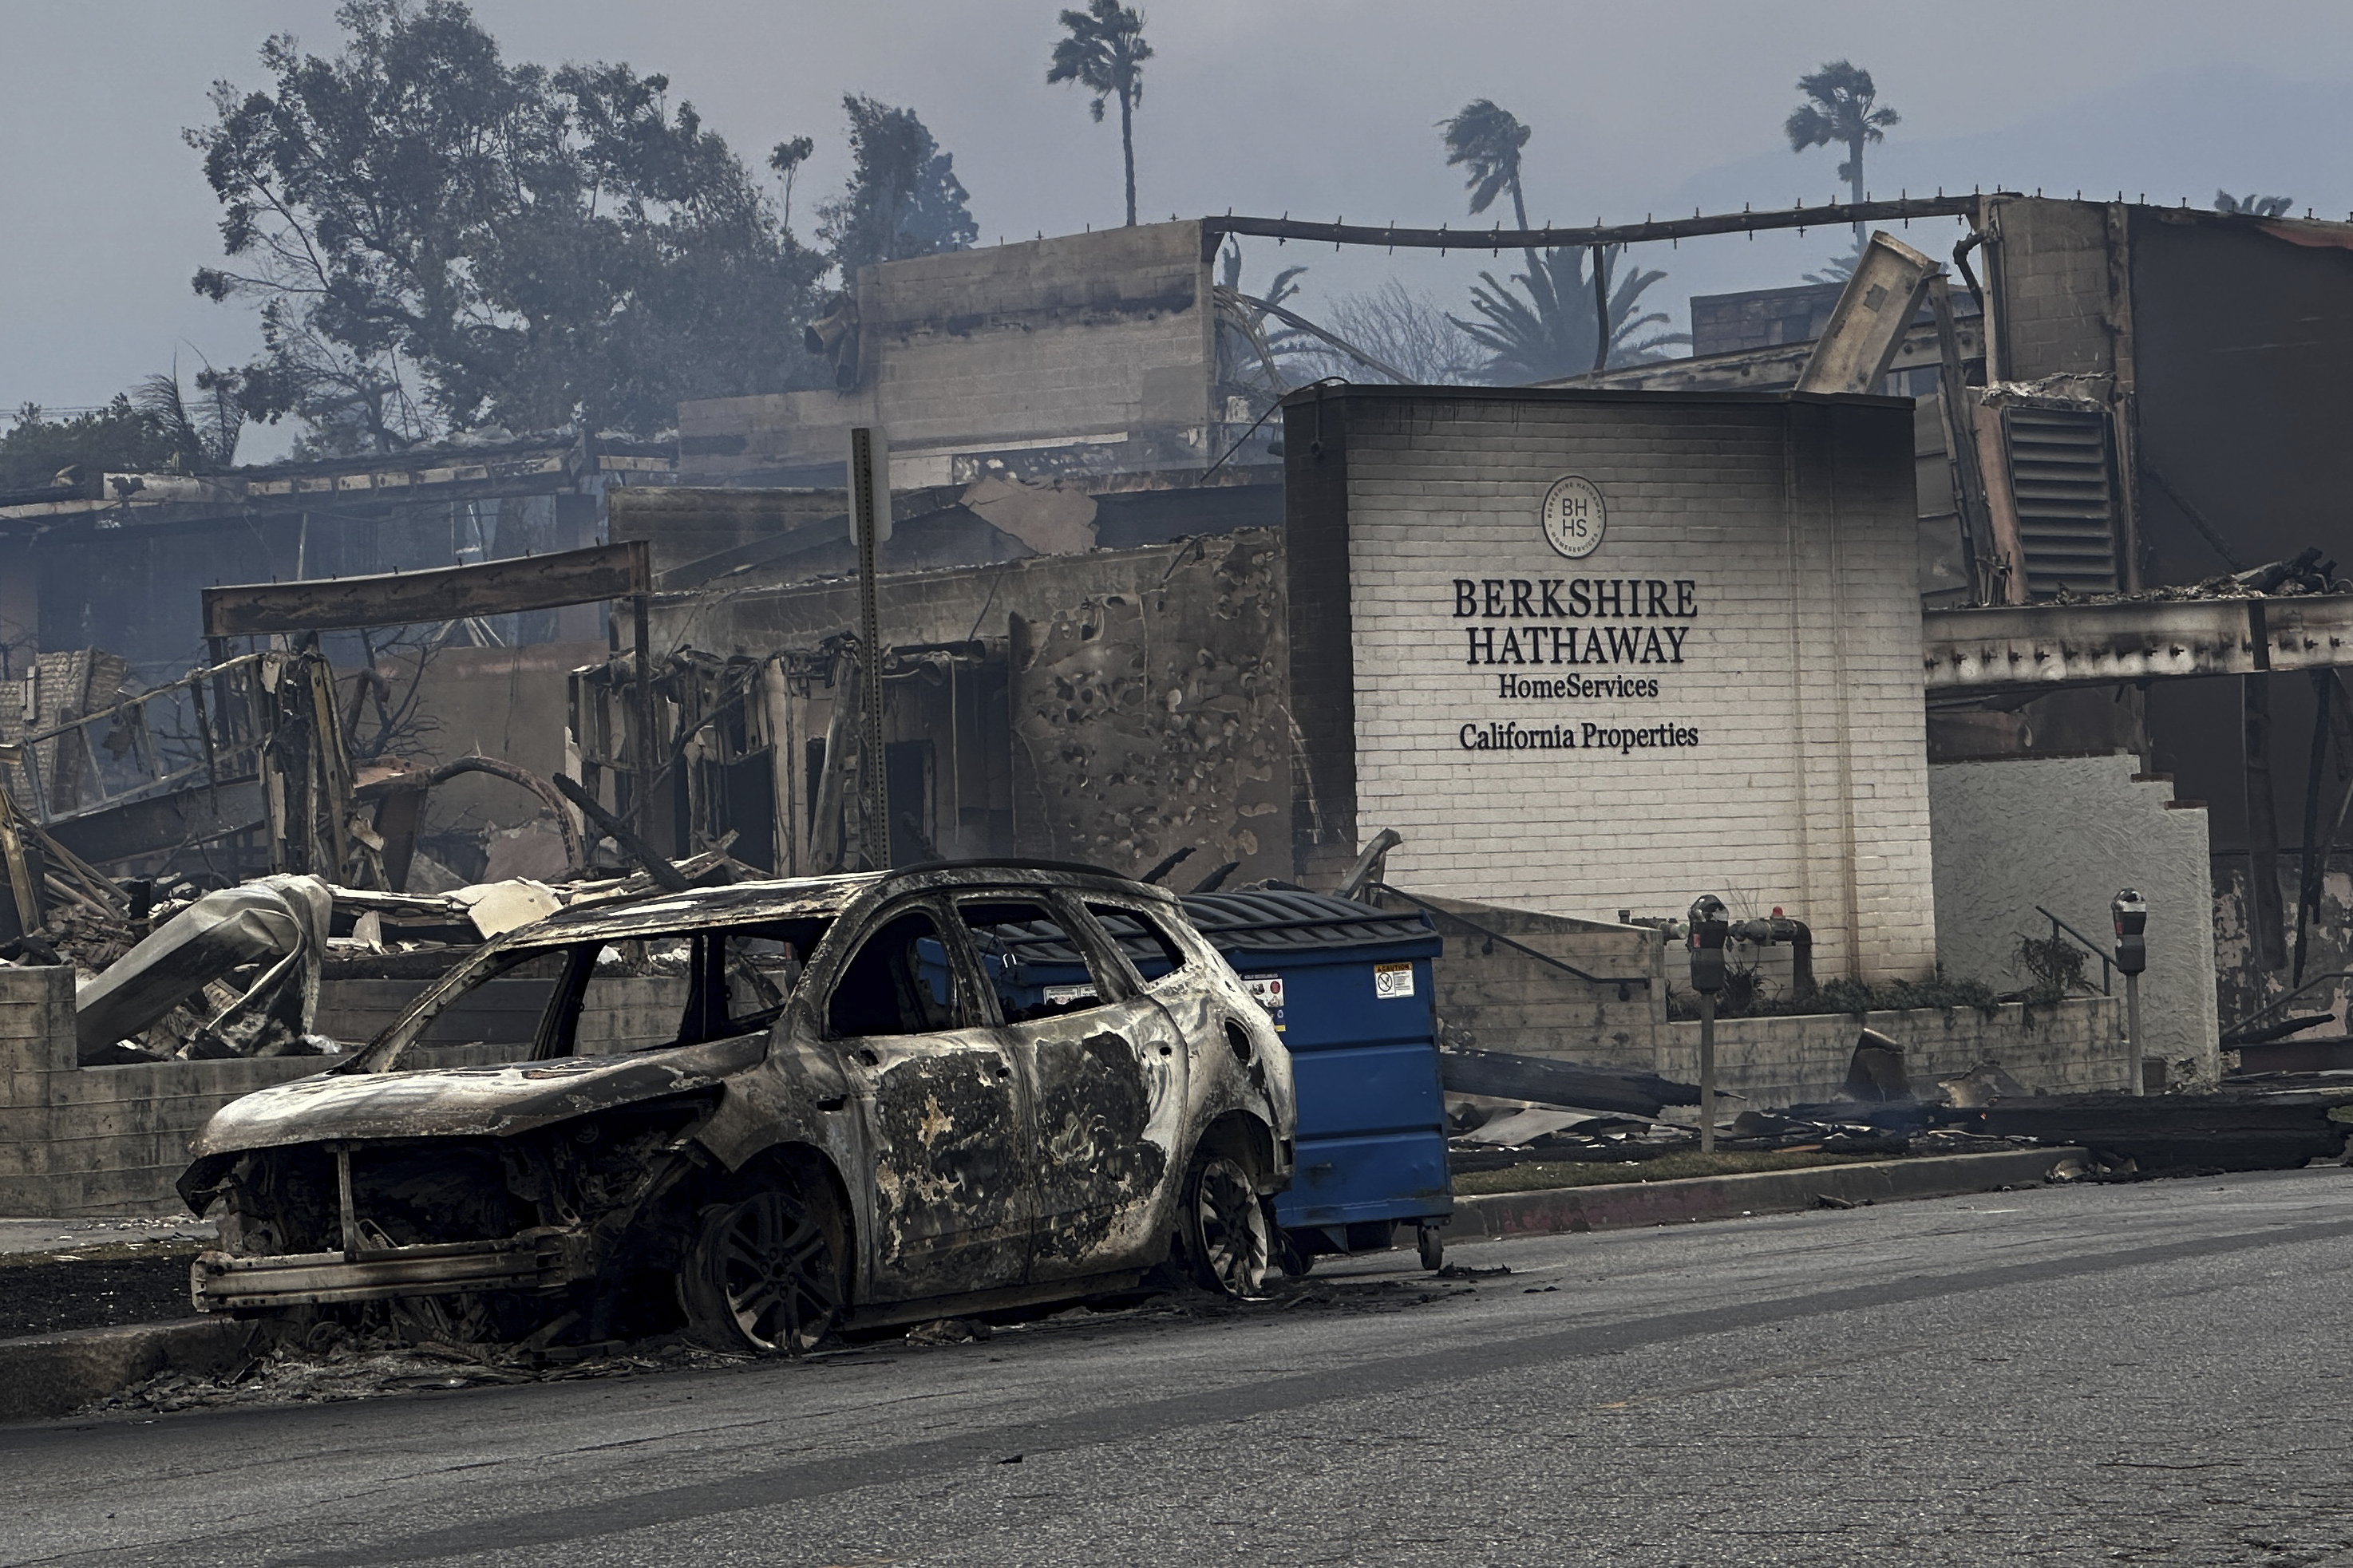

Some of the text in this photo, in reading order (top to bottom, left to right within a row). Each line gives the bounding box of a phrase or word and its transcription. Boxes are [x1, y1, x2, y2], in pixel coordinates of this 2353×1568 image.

[1562, 498, 1587, 517] BH
[1562, 518, 1588, 538] HS
[1453, 579, 1698, 618] BERKSHIRE
[1465, 626, 1689, 664] HATHAWAY
[1498, 672, 1659, 698] HomeServices
[1459, 721, 1699, 754] California Properties
